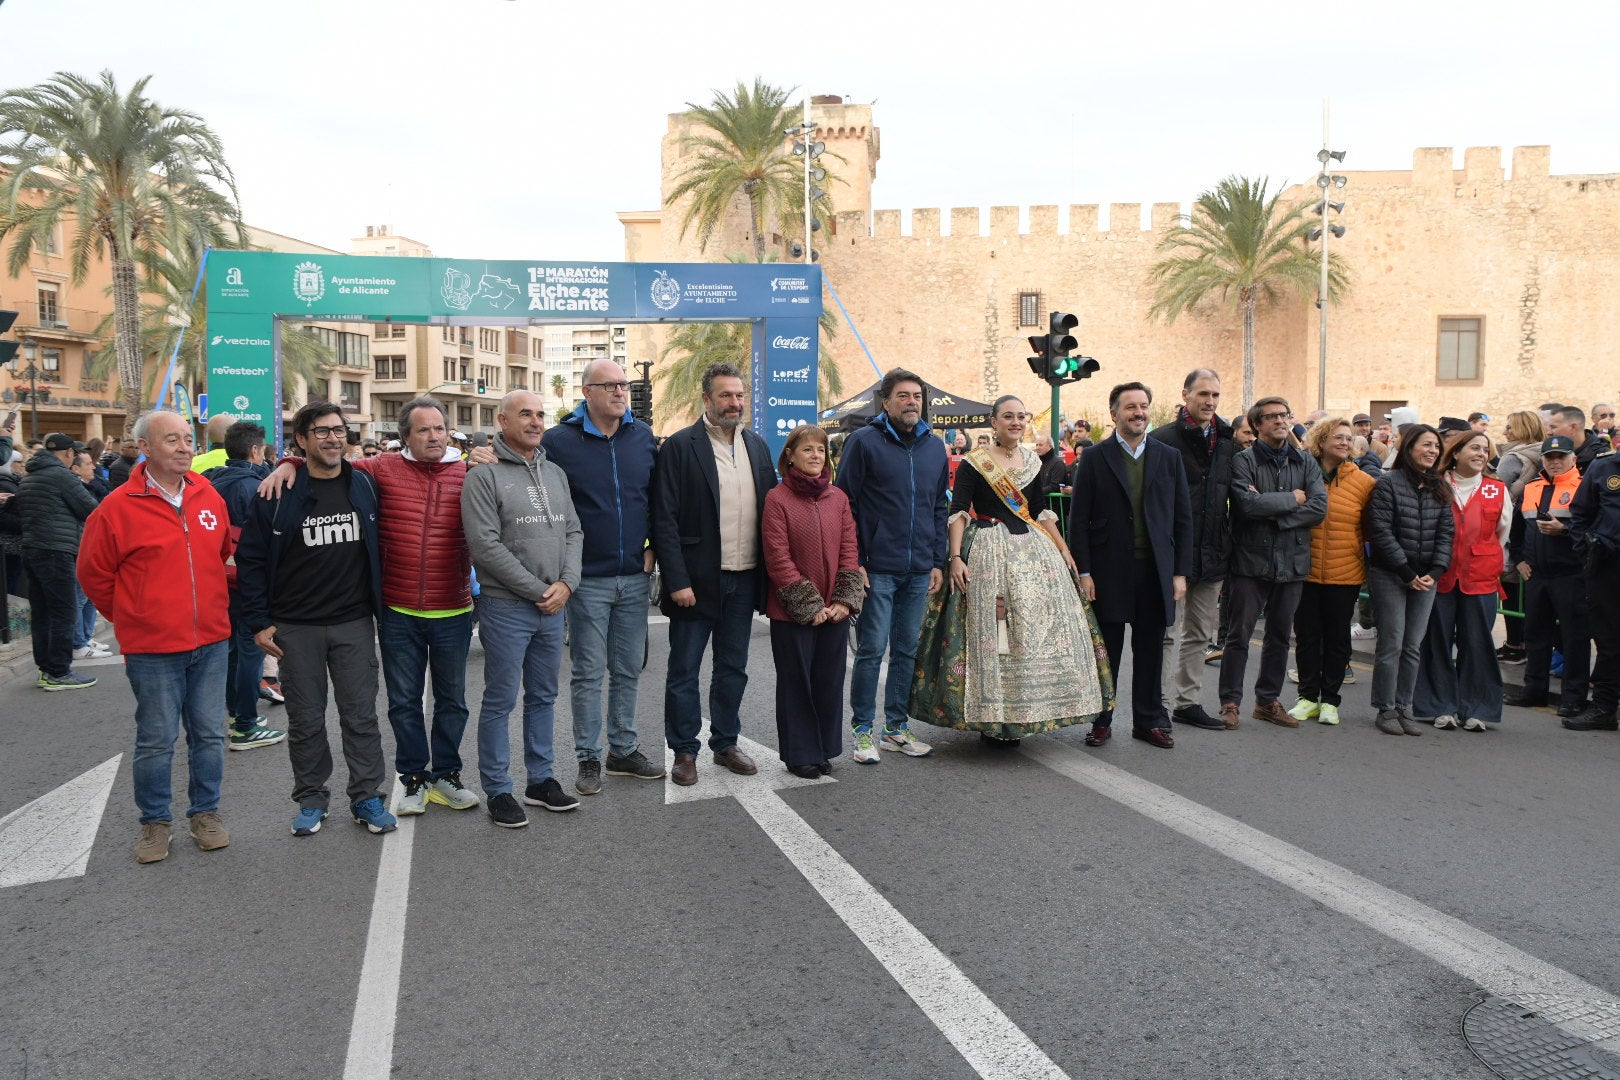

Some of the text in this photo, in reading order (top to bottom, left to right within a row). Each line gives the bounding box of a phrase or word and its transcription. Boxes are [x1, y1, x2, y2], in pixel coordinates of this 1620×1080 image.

[545, 266, 609, 278] MARATÓN
[331, 276, 396, 286] Ayuntamiento
[545, 276, 609, 284] INTERNACIONAL
[338, 286, 390, 295] de Alicante
[528, 283, 609, 298] Elche 42K
[528, 294, 609, 311] Alicante
[224, 337, 271, 346] vectalia
[772, 335, 811, 350] Coca-Cola
[302, 512, 352, 527] deportes
